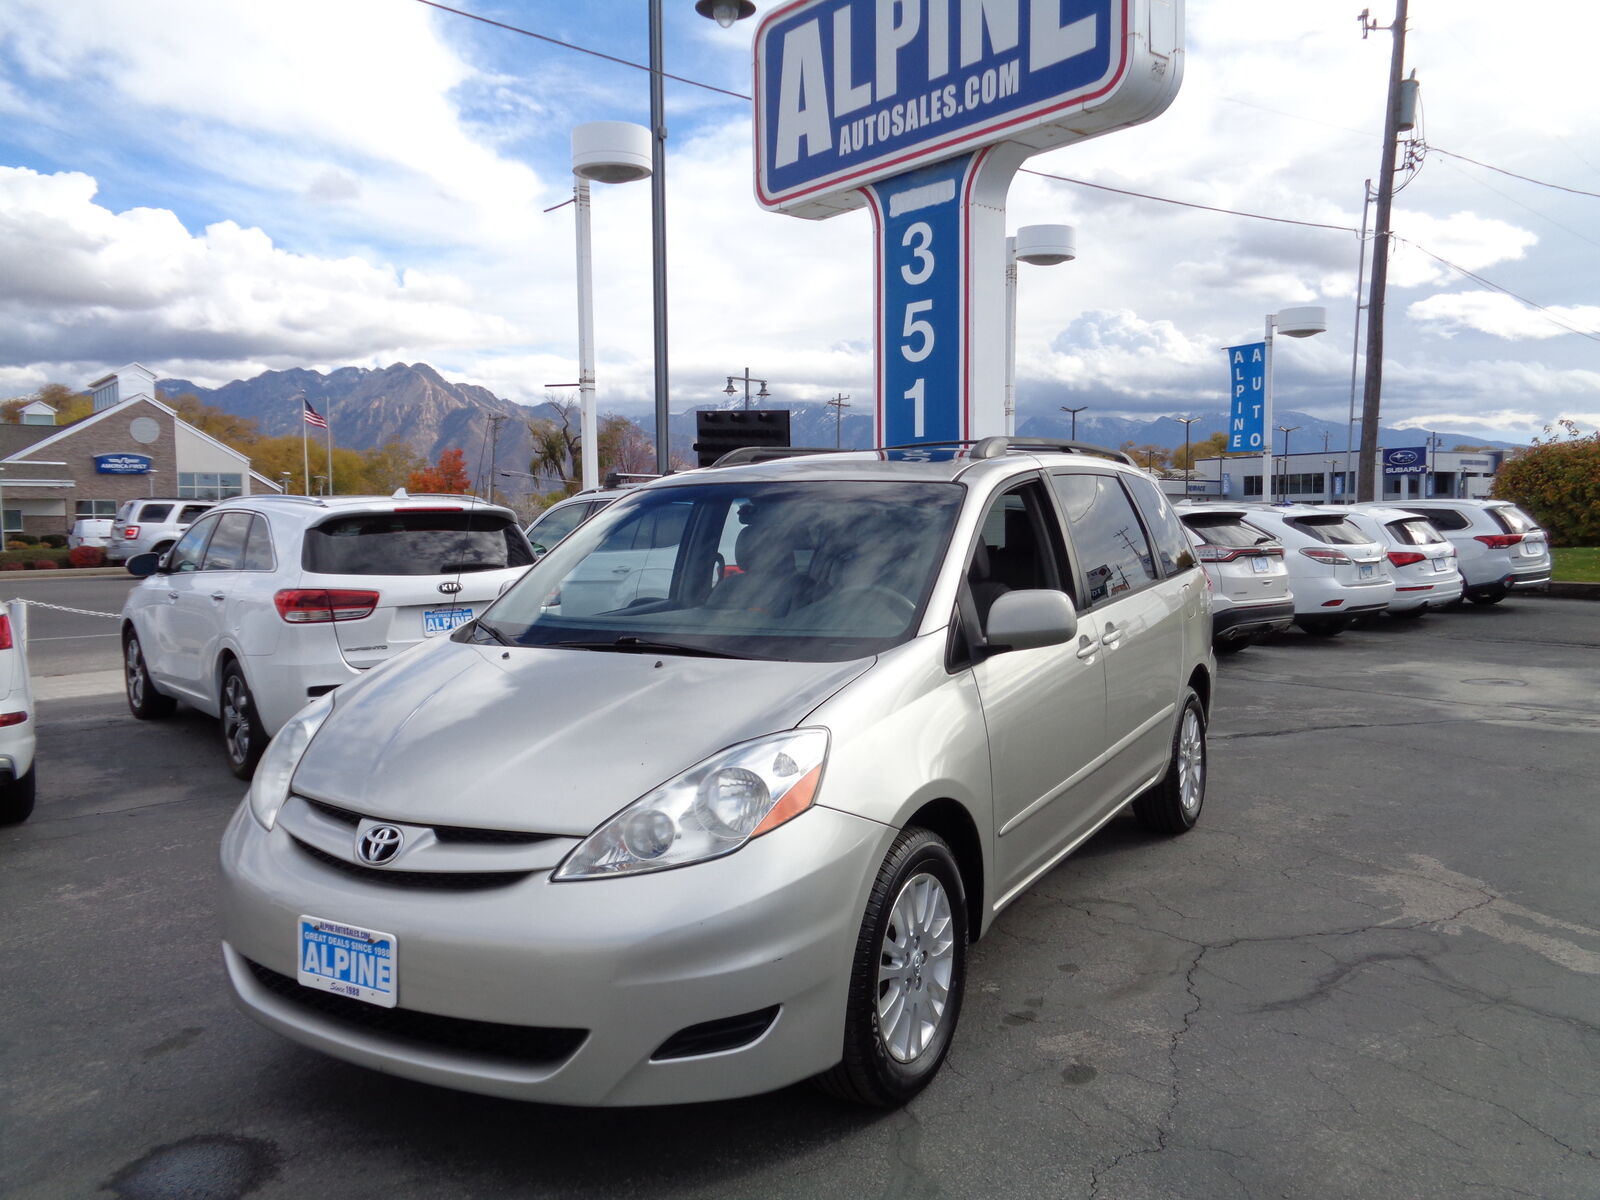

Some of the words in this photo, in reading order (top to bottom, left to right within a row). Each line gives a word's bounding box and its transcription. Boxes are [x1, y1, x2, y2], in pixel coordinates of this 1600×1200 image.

[838, 58, 1020, 157] AUTOSALES.COM
[1233, 351, 1245, 448] ALPINE
[1250, 348, 1262, 447] AUTO
[1386, 466, 1422, 474] SUBARU
[441, 583, 463, 592] KIA
[303, 941, 390, 991] ALPINE
[304, 932, 327, 943] GREAT
[328, 938, 350, 948] DEALS
[351, 942, 372, 953] SINCE
